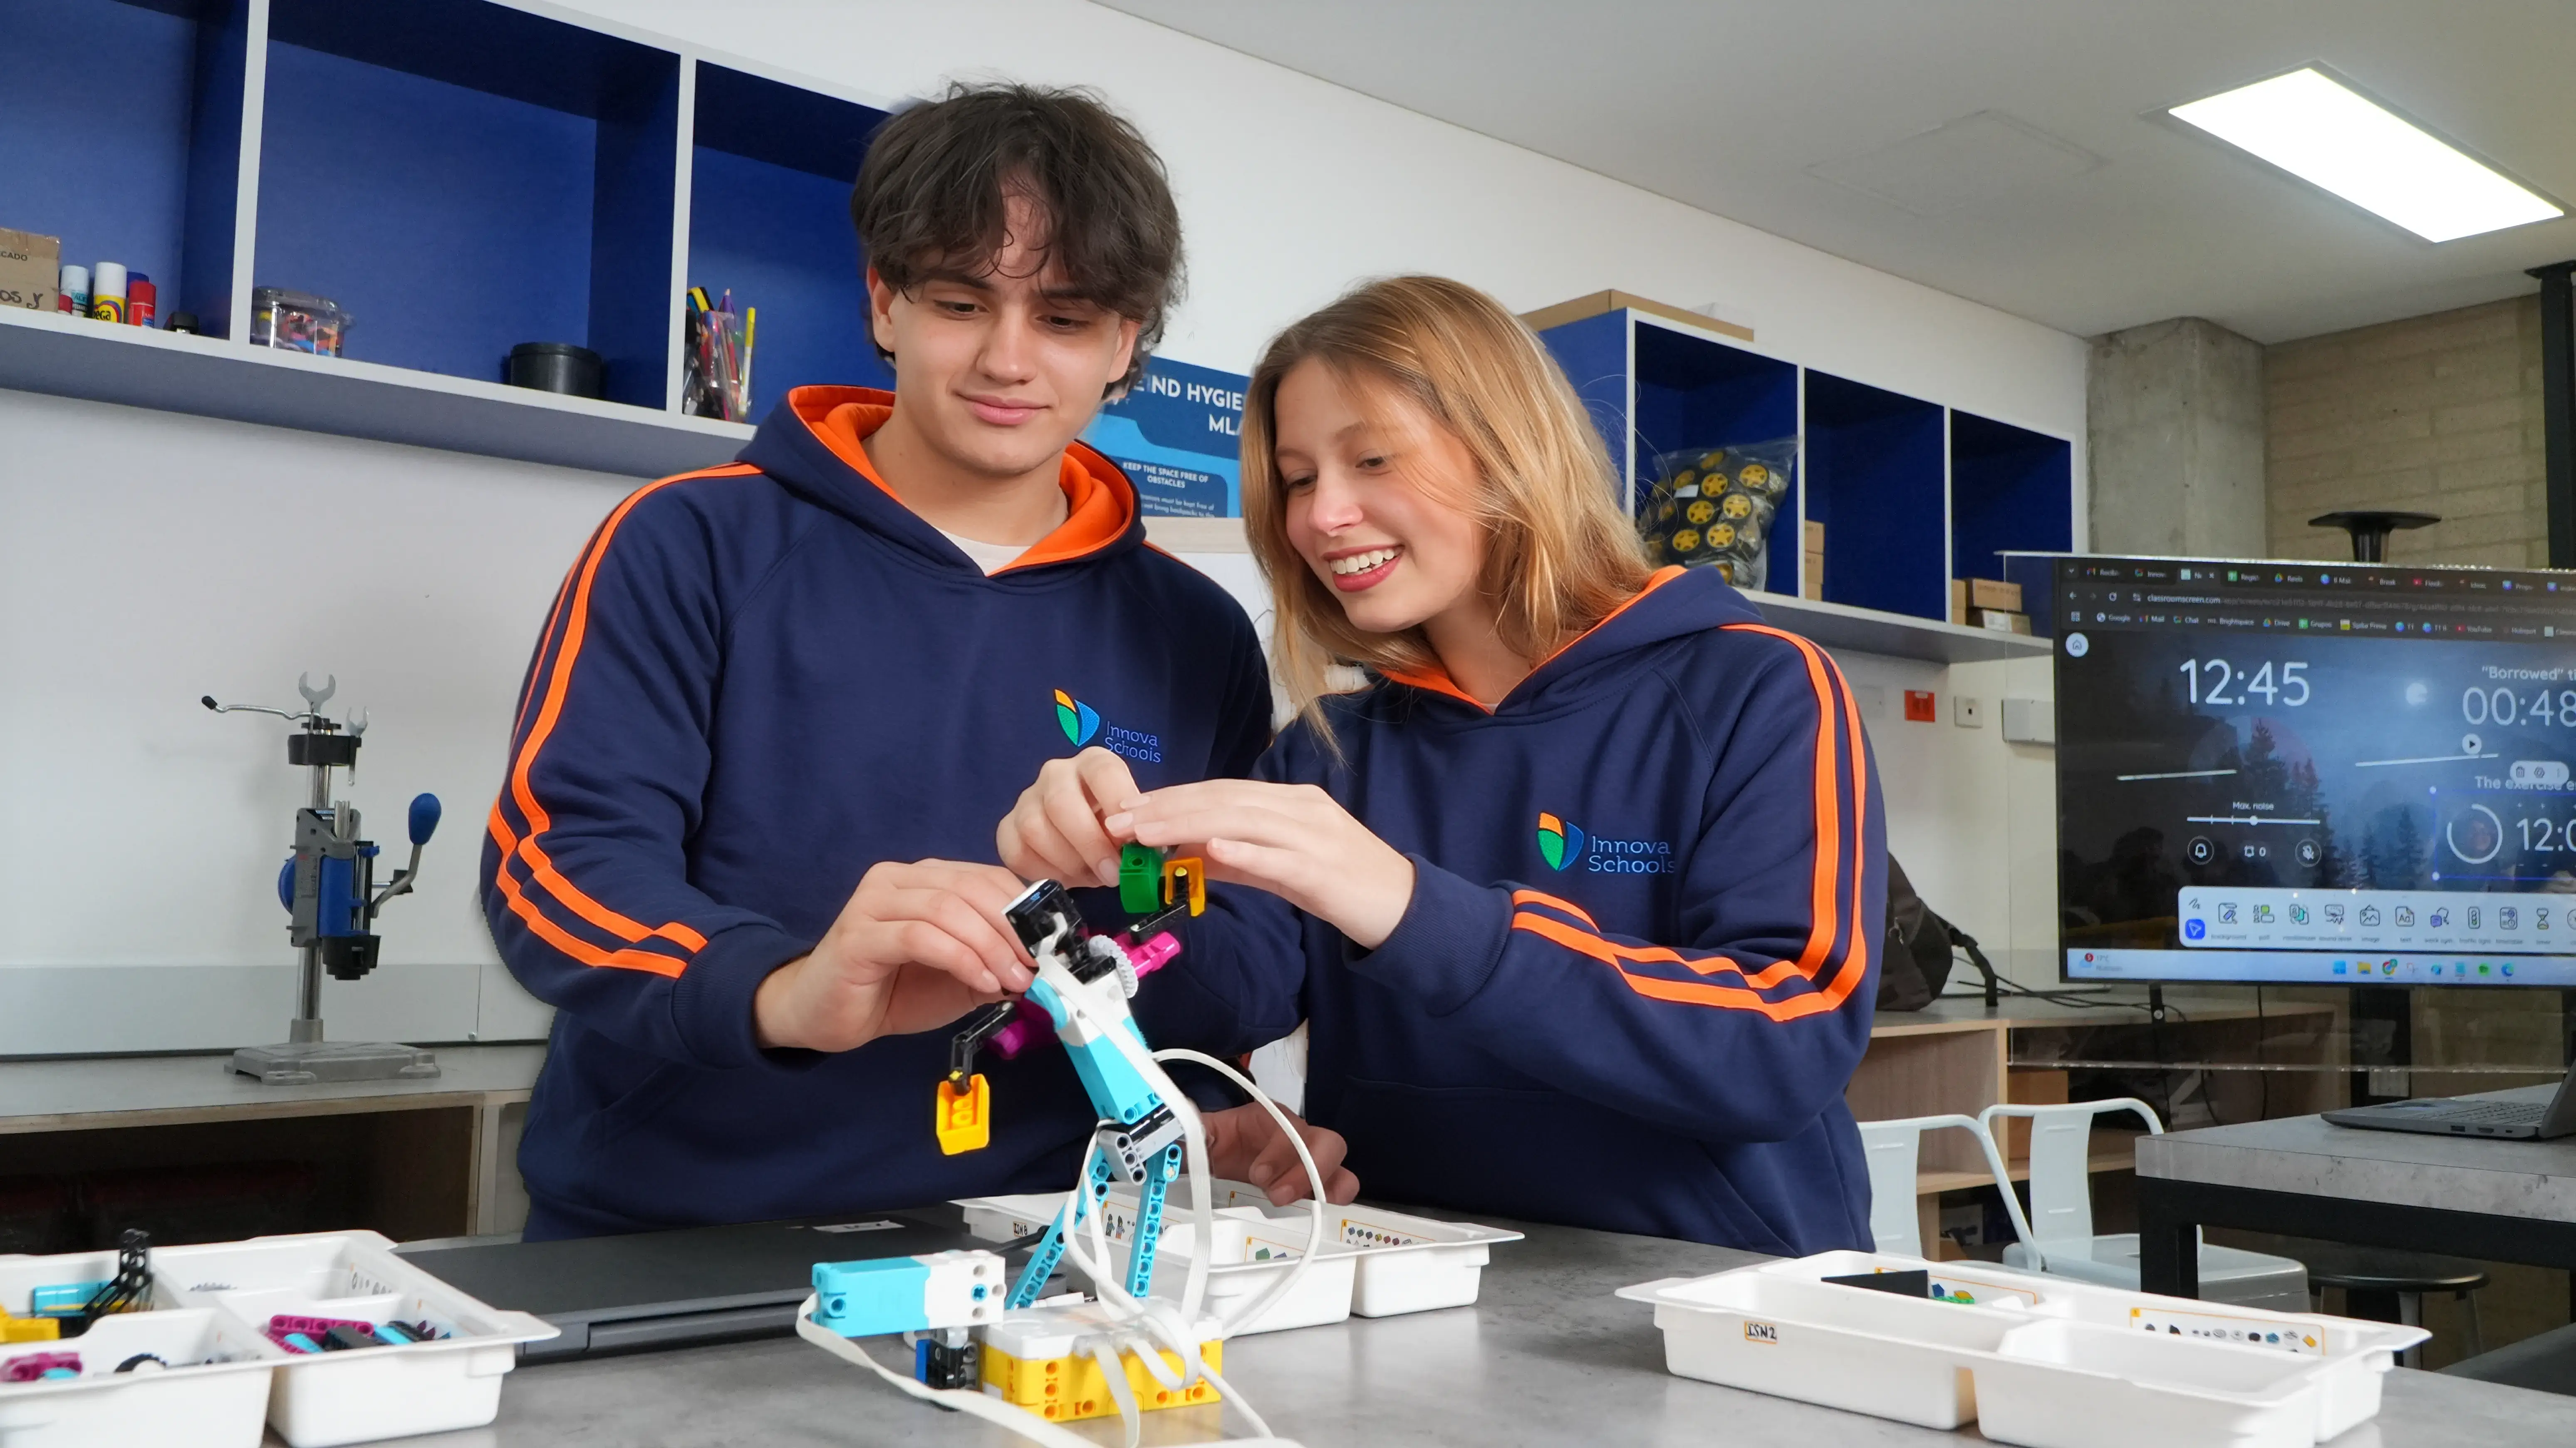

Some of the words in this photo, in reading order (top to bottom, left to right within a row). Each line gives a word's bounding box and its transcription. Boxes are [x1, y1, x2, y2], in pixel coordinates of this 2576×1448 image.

[0, 251, 28, 261] CADO
[1150, 375, 1181, 398] ND
[1187, 383, 1243, 411] HYGIE
[1123, 461, 1142, 471] KEEP
[1143, 464, 1157, 474] THE
[1158, 467, 1179, 478] SPACE
[1180, 471, 1198, 481] FREE
[1199, 474, 1209, 483] OF
[1147, 474, 1185, 488] OBSTACLES
[2180, 658, 2310, 706] 12:45
[2462, 686, 2576, 727] 00:48
[1106, 720, 1158, 747] Innova
[2474, 776, 2502, 789] The
[2253, 802, 2274, 811] noise
[1591, 836, 1671, 854] Innova
[1588, 855, 1675, 873] Schools
